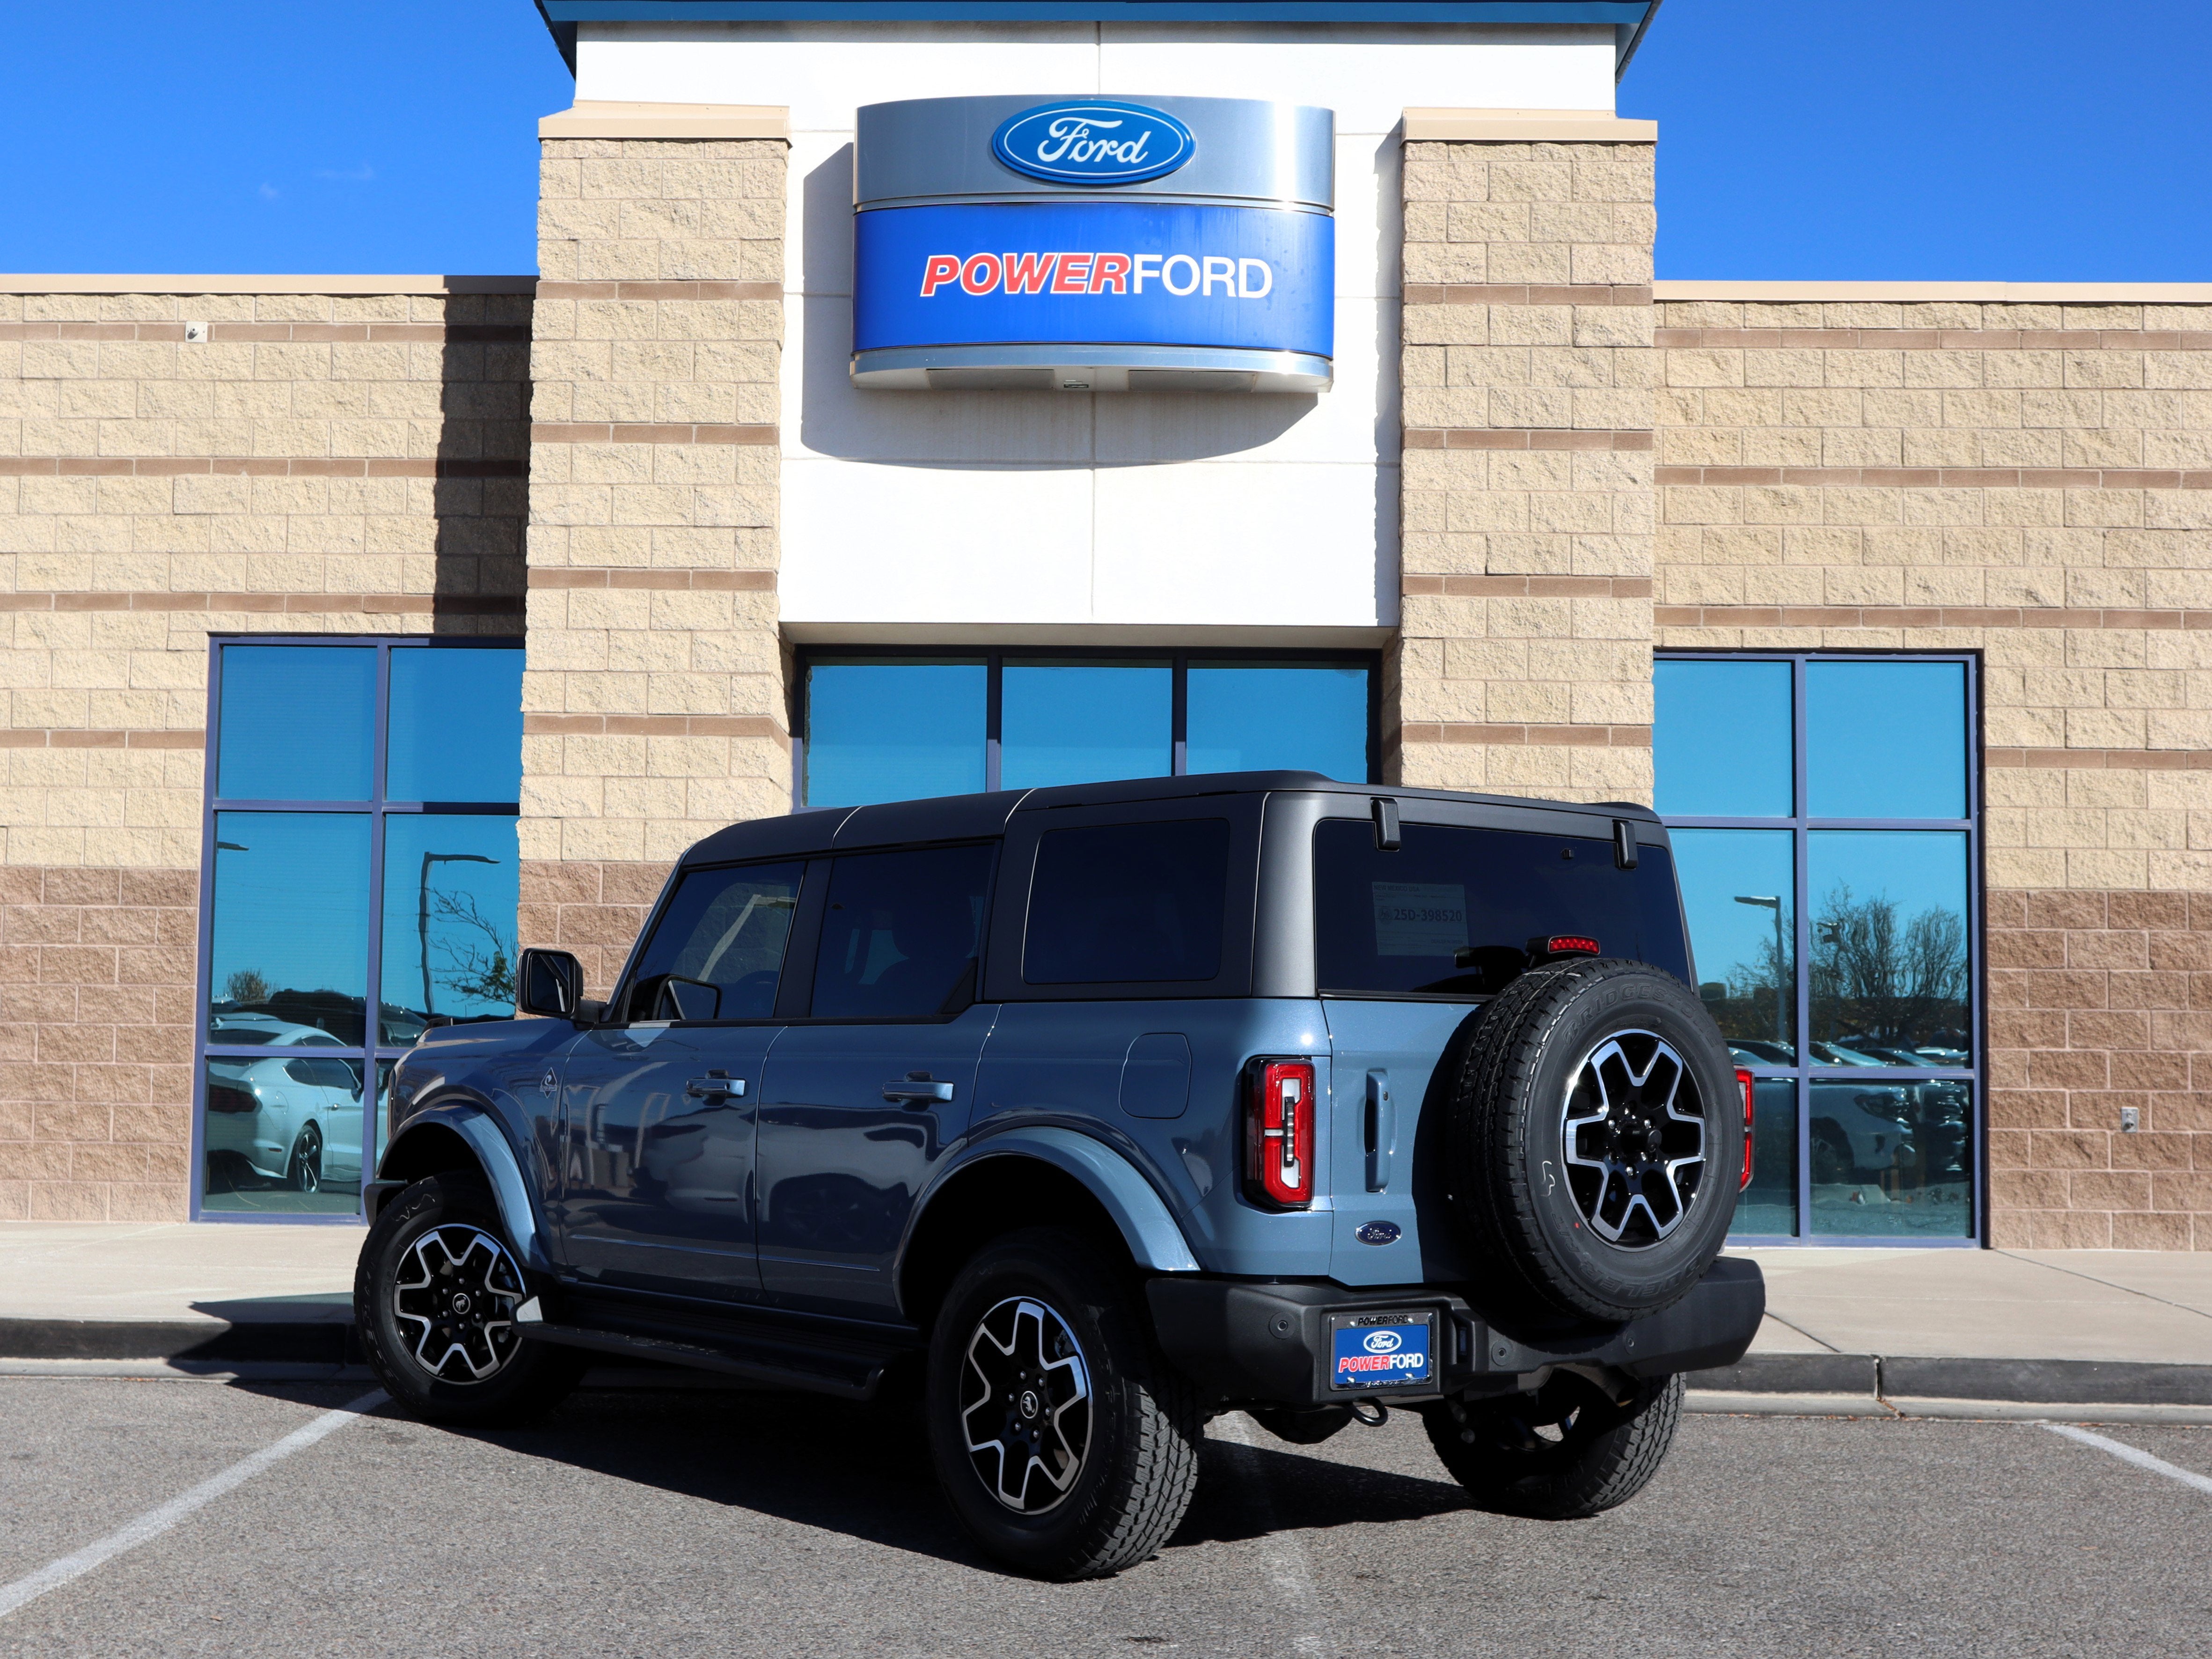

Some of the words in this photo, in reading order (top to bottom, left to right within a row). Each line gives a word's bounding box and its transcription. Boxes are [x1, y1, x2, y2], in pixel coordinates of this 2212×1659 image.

[1037, 117, 1151, 164] Ford
[920, 252, 1273, 299] POWERFORD
[1394, 909, 1462, 922] 25D-398520
[1367, 1227, 1392, 1240] Ford
[1357, 1315, 1409, 1327] POWERFORD
[1370, 1335, 1393, 1349] Ford
[1338, 1353, 1424, 1373] POWERFORD
